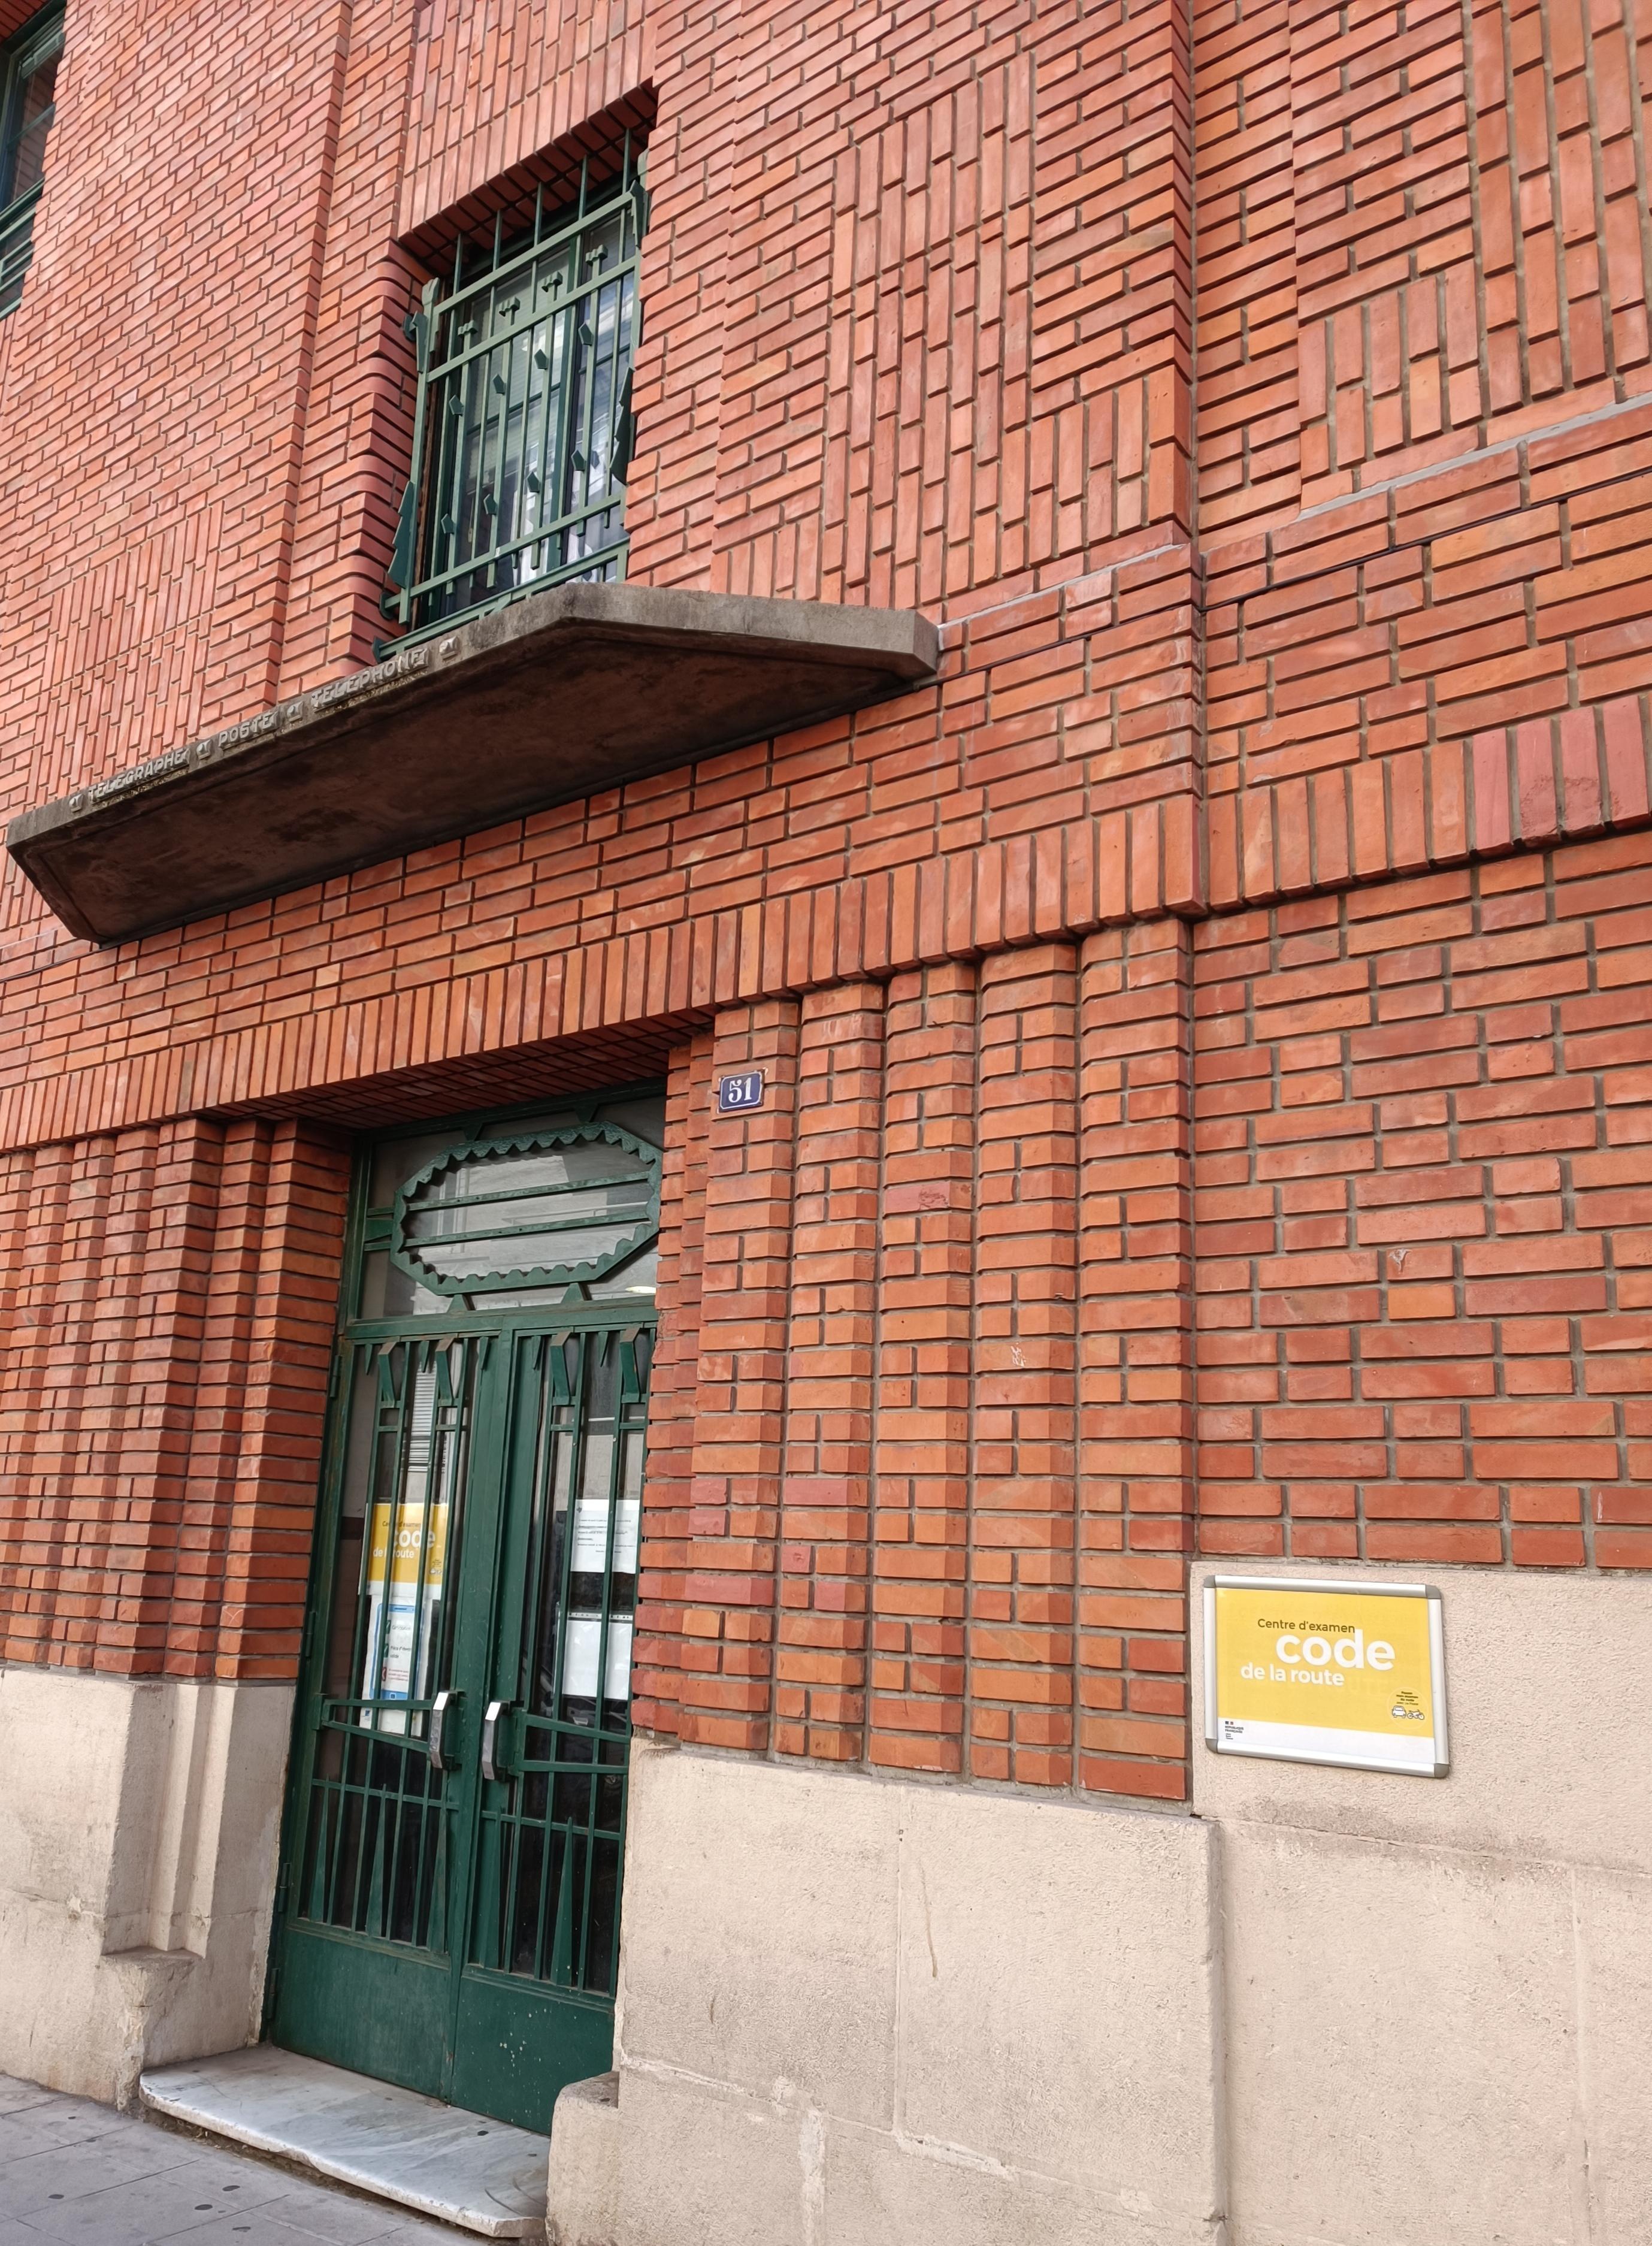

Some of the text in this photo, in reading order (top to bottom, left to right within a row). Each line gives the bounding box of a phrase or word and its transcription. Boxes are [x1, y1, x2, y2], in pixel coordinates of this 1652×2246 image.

[88, 647, 428, 803] TELEGRAPHE POSTE TELEPHONE
[728, 1077, 752, 1104] 51
[373, 1547, 383, 1558] de
[1257, 1618, 1356, 1634] Centre d'examen
[1276, 1628, 1396, 1671] code
[1240, 1662, 1345, 1686] de la route
